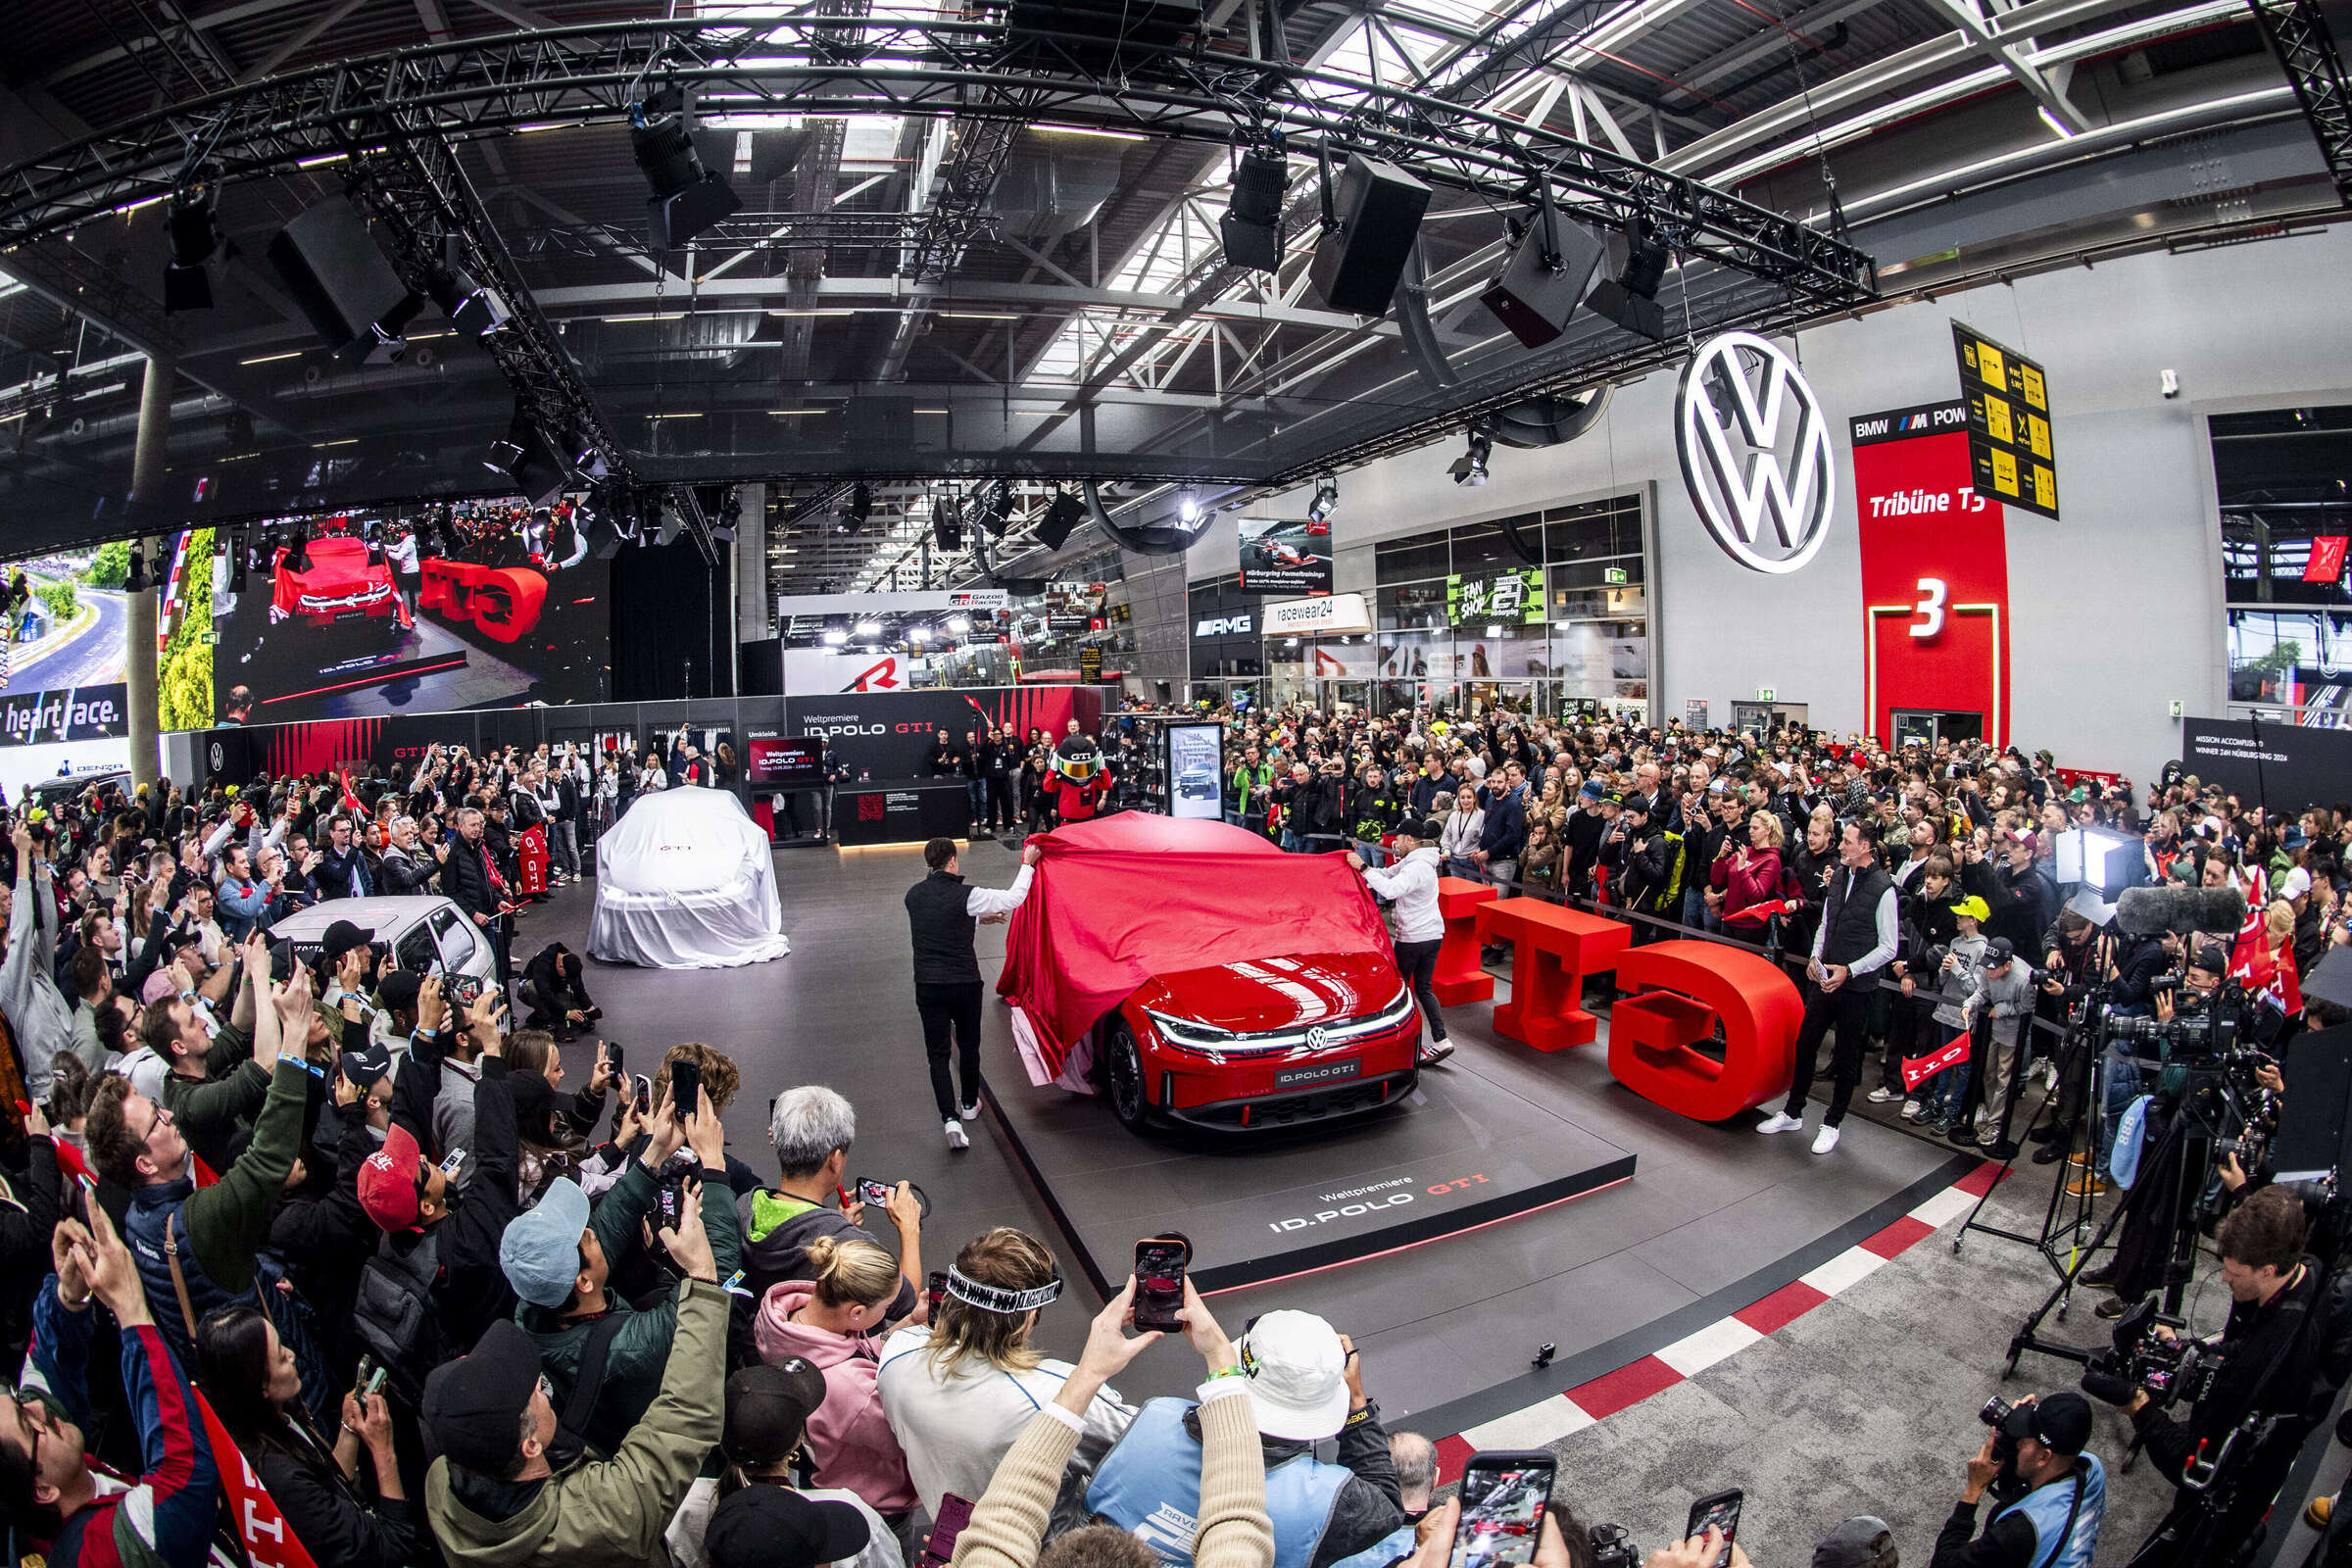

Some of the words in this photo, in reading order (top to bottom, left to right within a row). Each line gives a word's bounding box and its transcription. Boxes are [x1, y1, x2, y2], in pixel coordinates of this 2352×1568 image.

[1855, 418, 1889, 438] BMW
[1934, 407, 1967, 425] POW
[1870, 488, 1950, 518] Tribüne
[1246, 569, 1281, 578] Nürburgring
[1463, 580, 1484, 603] FAN
[1277, 601, 1333, 621] racewear24
[1461, 597, 1486, 620] SHOP
[1908, 576, 1948, 639] 3
[1210, 614, 1252, 635] AMG
[5, 698, 62, 732] heart
[804, 713, 859, 724] Weltpremiere
[748, 729, 778, 738] Umkleide
[804, 724, 886, 737] ID.POLO
[895, 721, 933, 734] GTI
[394, 746, 427, 759] GTI
[2195, 746, 2220, 756] WINNER
[2221, 737, 2264, 748] ACCOMPLISHD
[765, 749, 805, 759] Weltpremiere
[1070, 752, 1092, 761] GTI
[76, 763, 123, 772] DENZA
[528, 859, 539, 892] GTI
[1332, 1064, 1355, 1075] GTI
[2118, 1114, 2135, 1146] 888
[1318, 1176, 1414, 1202] Weltpremiere
[1268, 1192, 1414, 1234] ID.POLO
[1426, 1173, 1491, 1196] GTI
[1163, 1508, 1199, 1531] RAVE
